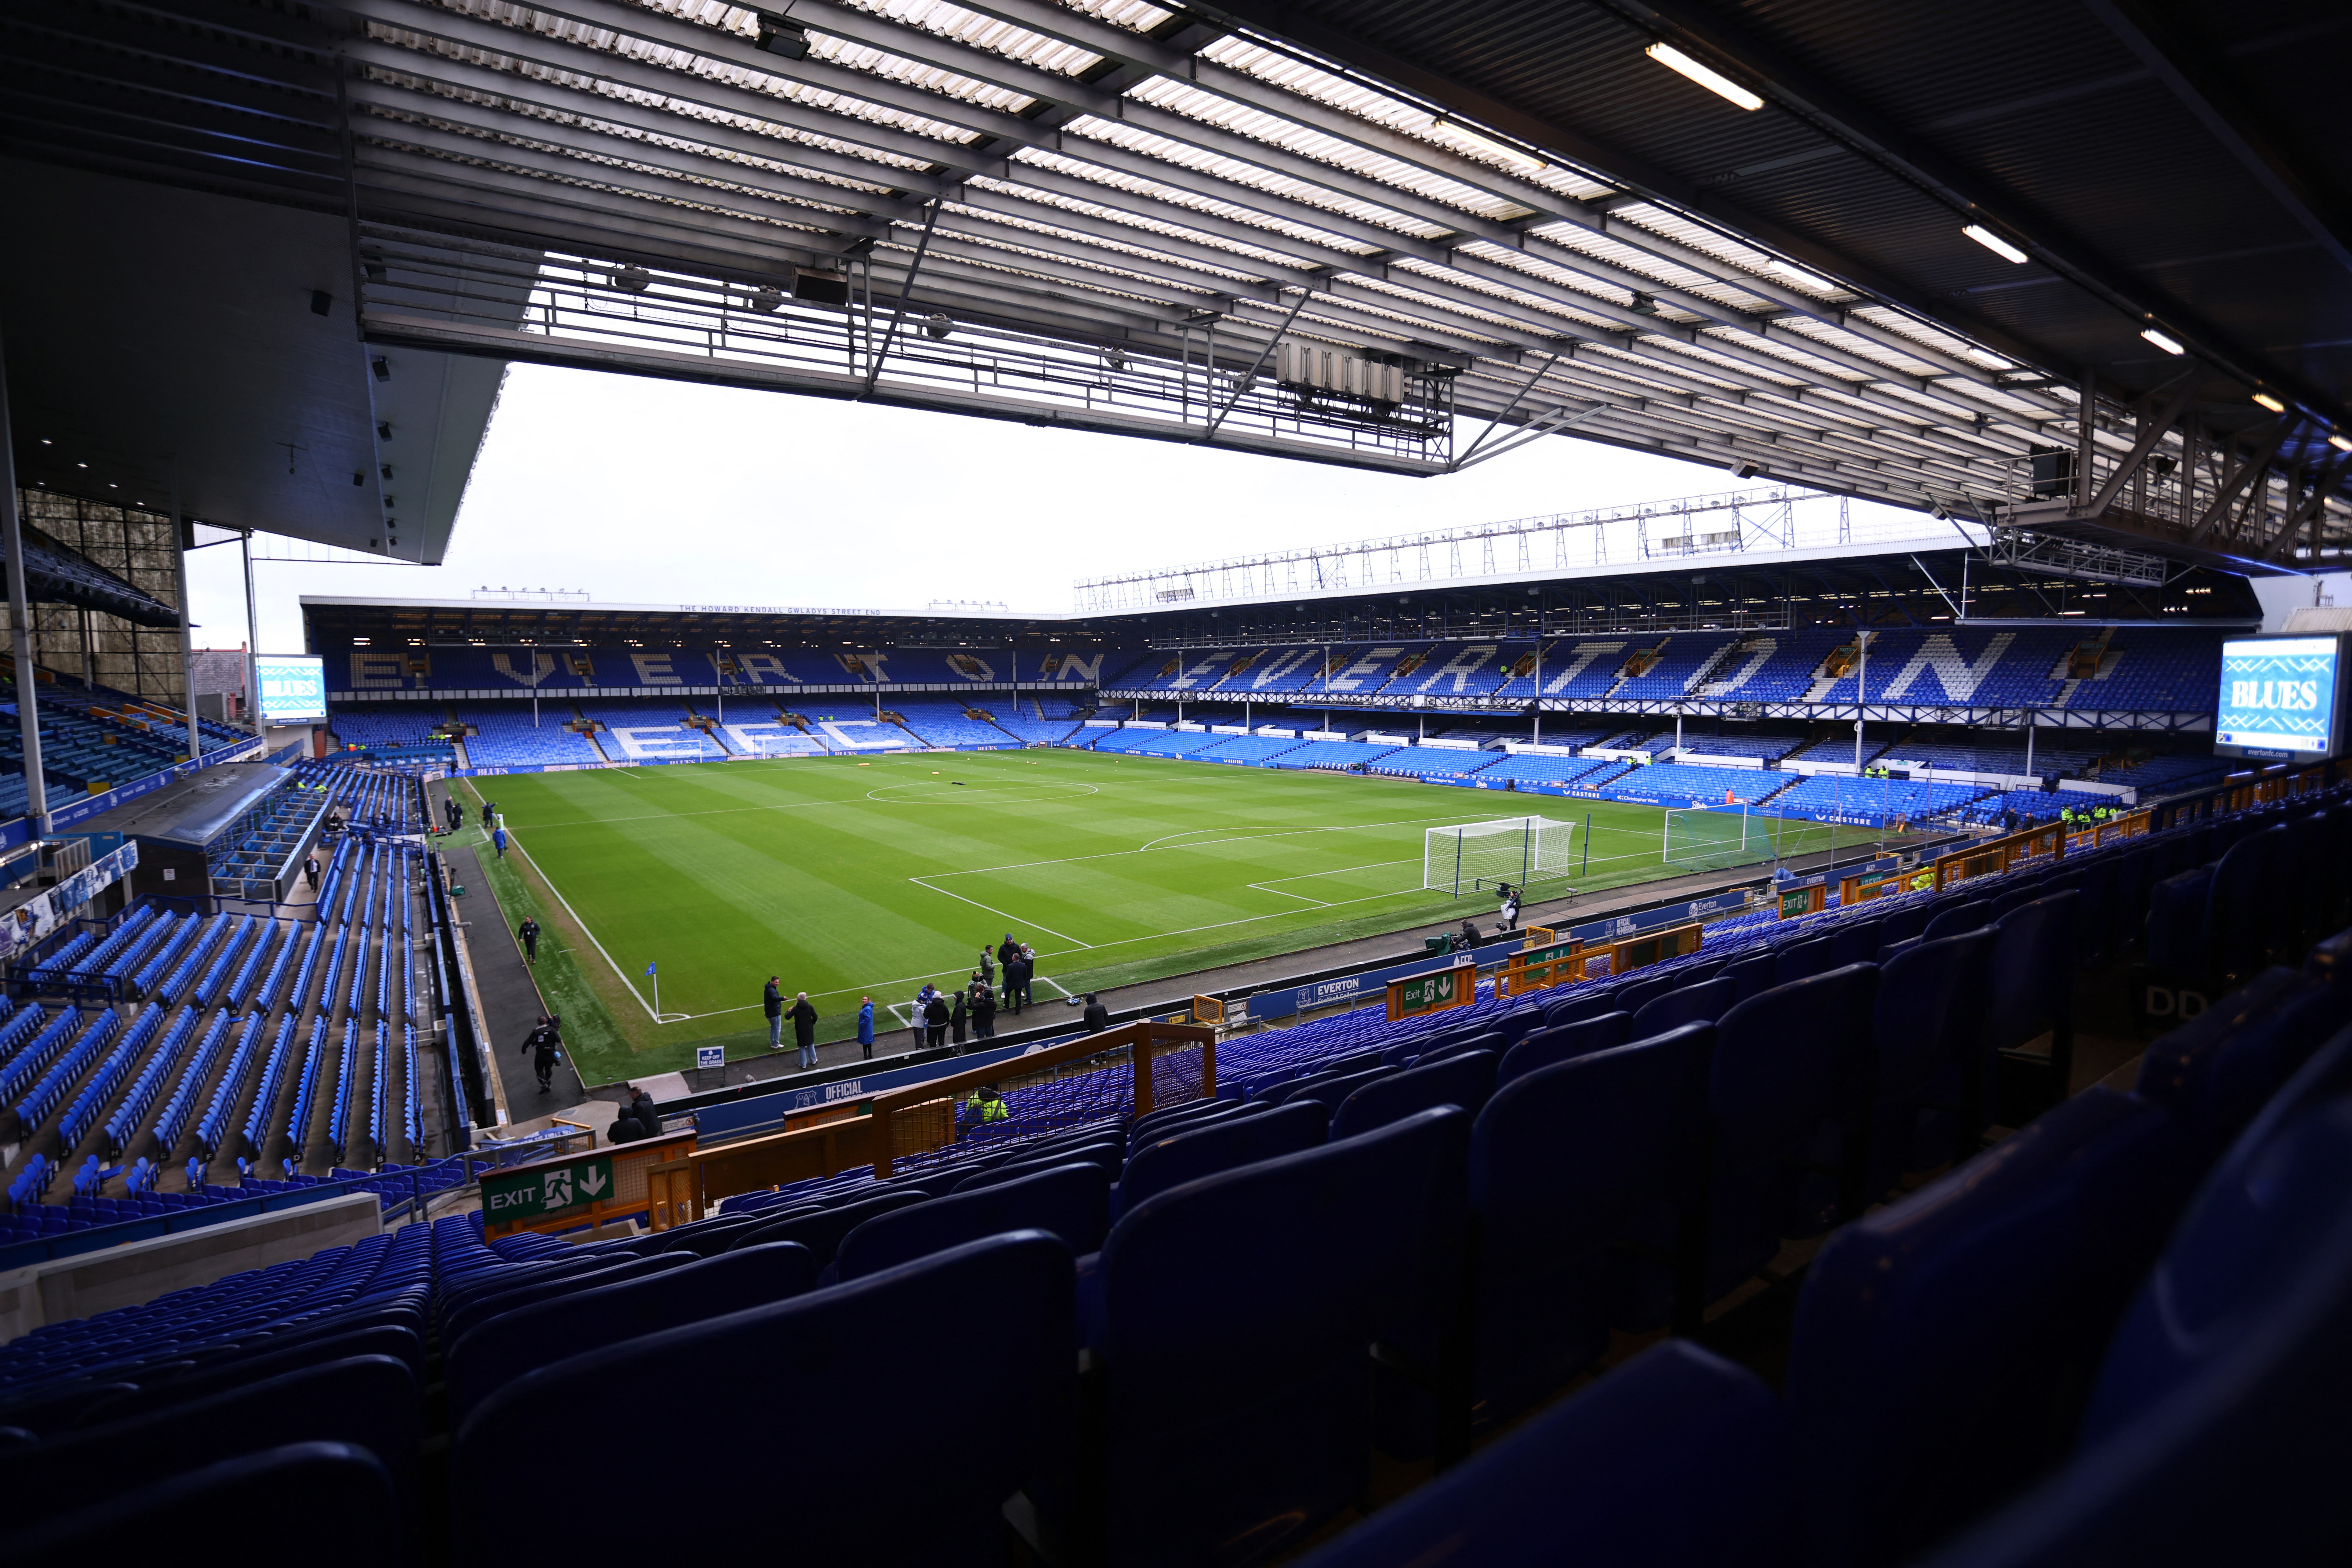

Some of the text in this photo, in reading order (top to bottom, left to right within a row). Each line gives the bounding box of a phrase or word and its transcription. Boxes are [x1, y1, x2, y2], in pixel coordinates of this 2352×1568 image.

[350, 653, 1104, 688] EVERTON
[1172, 633, 2016, 702] EVERTON
[262, 680, 317, 697] BLUES
[2231, 681, 2317, 710] BLUES
[610, 720, 905, 757] EFC
[2247, 749, 2288, 758] evertonfc.com
[477, 767, 509, 776] BLUES
[1475, 780, 1488, 788] Stake
[1829, 815, 1871, 825] CASTORE
[1807, 875, 1825, 884] EVERTON
[1698, 900, 1717, 911] Everton
[1783, 898, 1797, 911] EXIT
[1617, 917, 1630, 927] OFFICIAL
[1616, 924, 1637, 936] MEMBERSHIP
[1318, 978, 1359, 996] EVERTON
[1406, 989, 1420, 1000] Exit
[826, 1080, 863, 1100] OFFICIAL
[490, 1187, 536, 1210] EXIT
